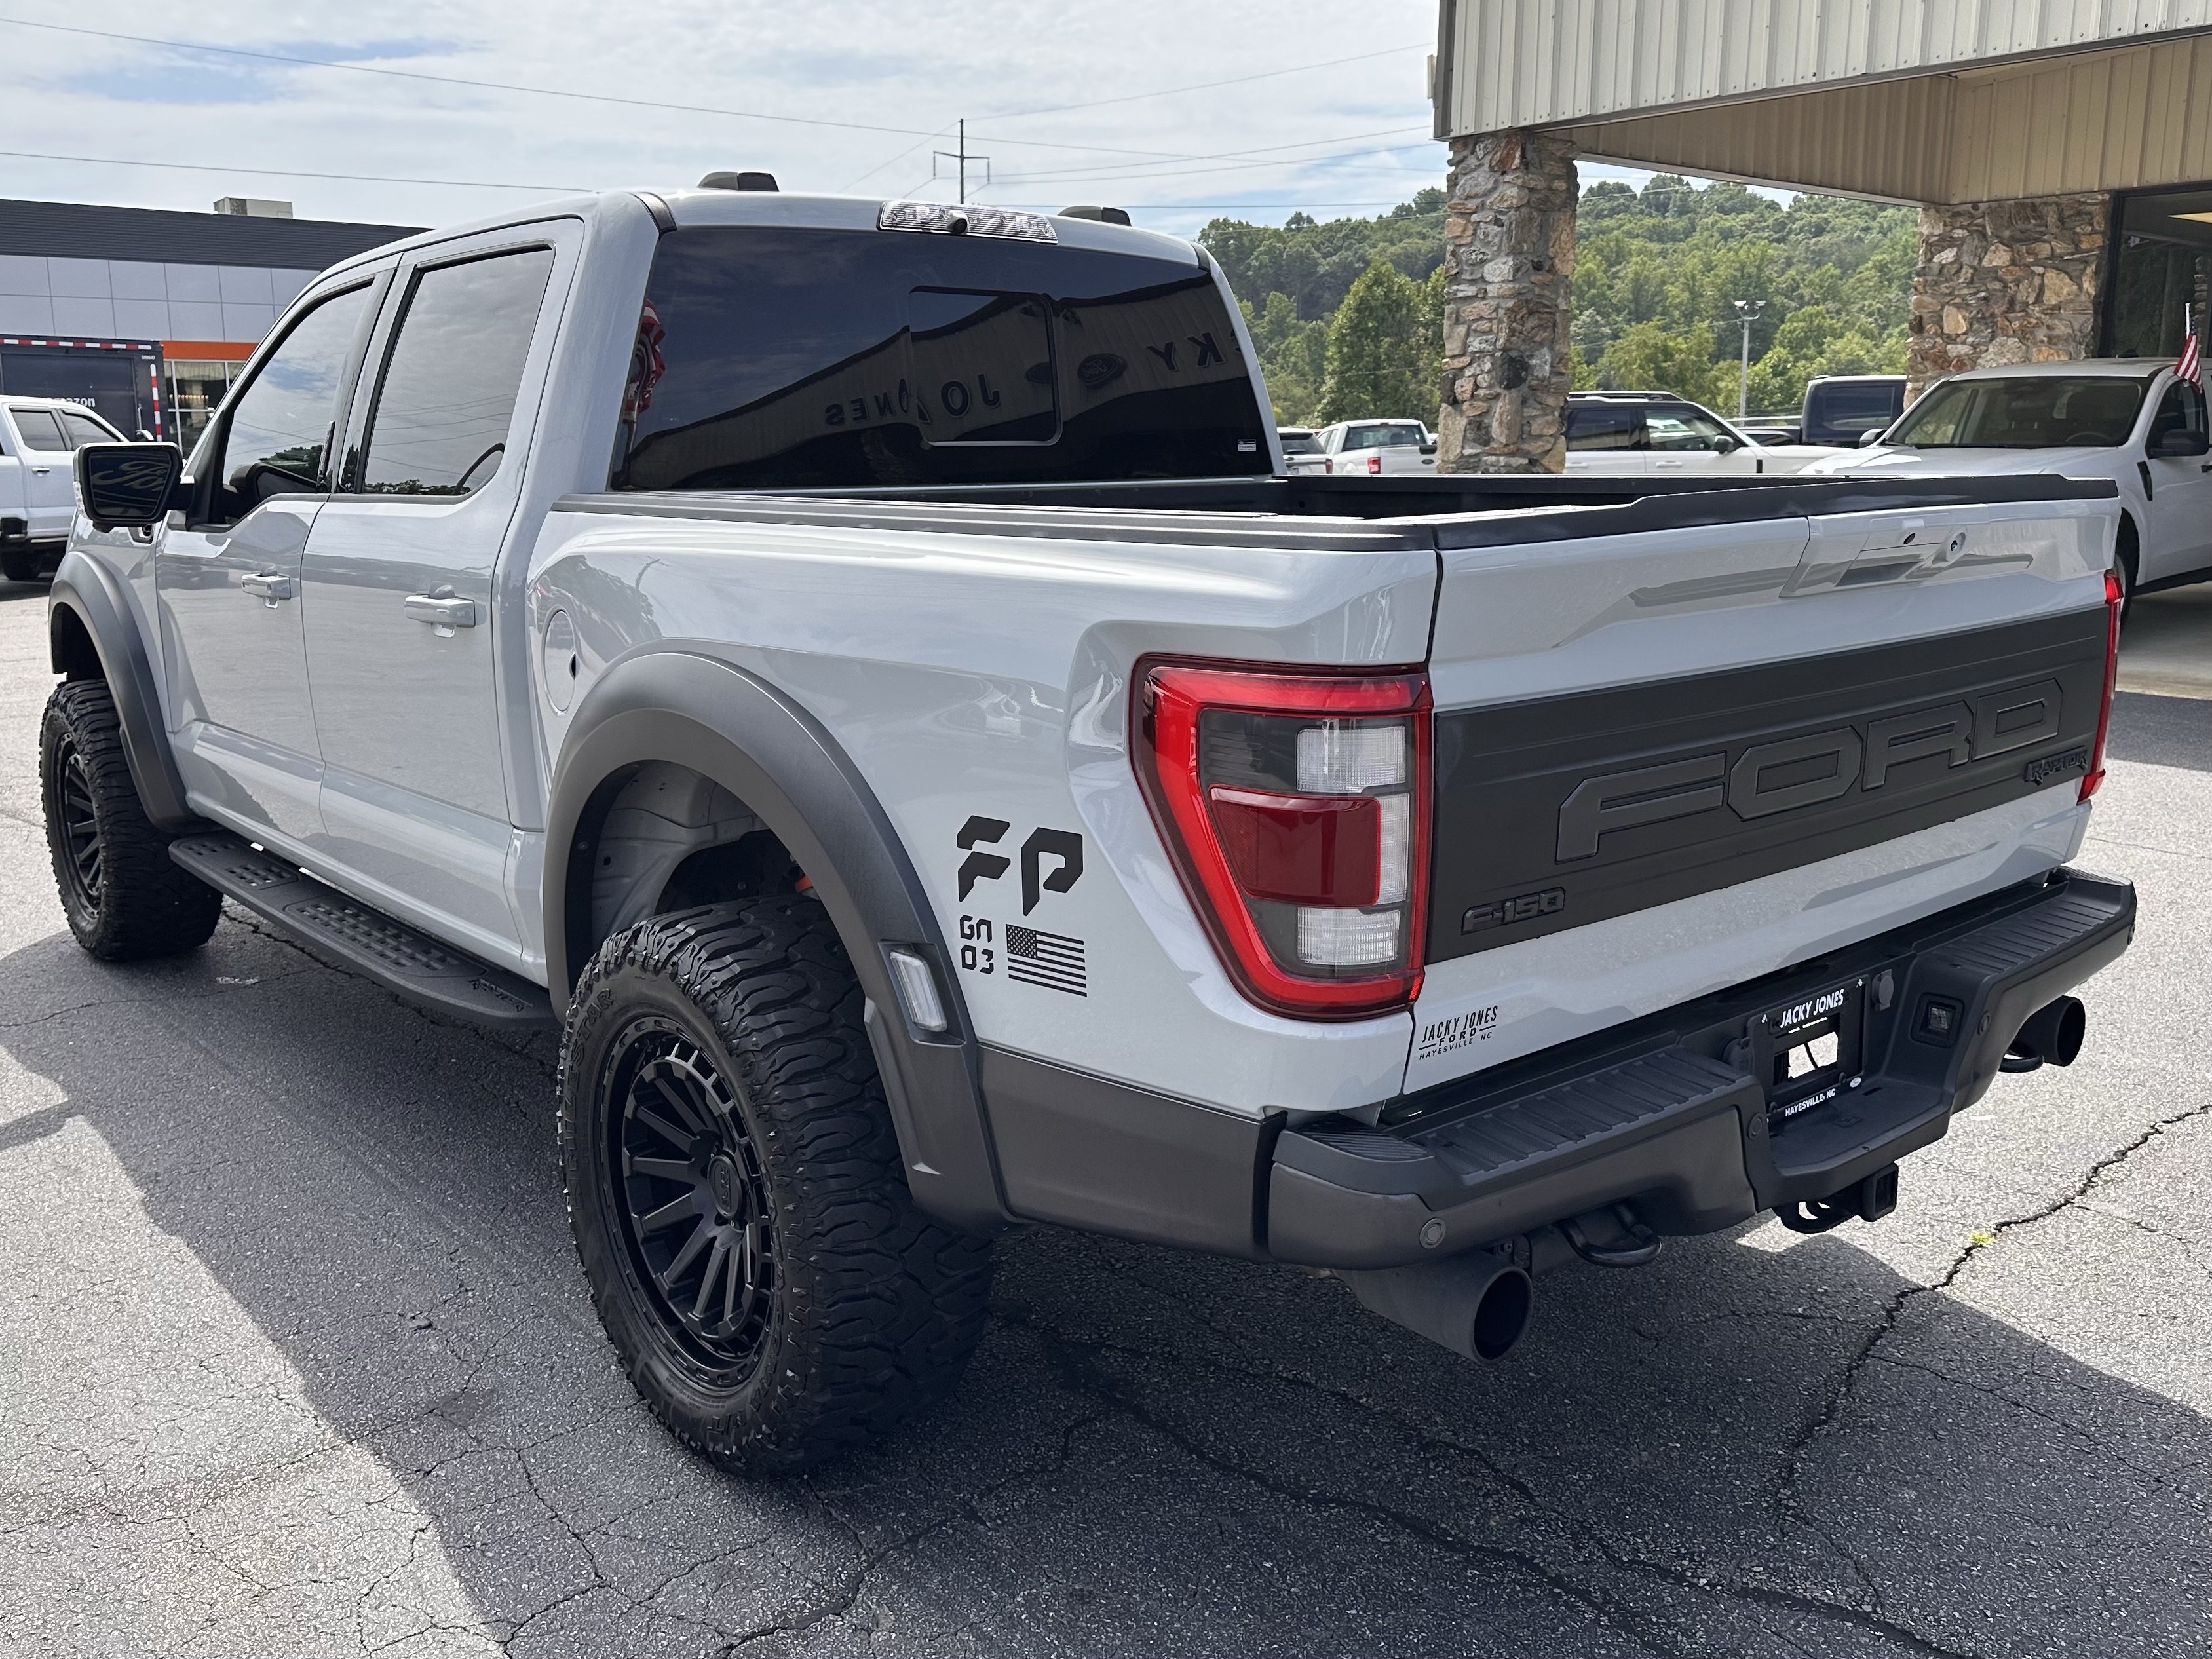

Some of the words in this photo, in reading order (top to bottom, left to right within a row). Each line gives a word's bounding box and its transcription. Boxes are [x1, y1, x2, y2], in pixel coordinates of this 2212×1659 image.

[1556, 678, 2063, 864] FORD
[2025, 748, 2088, 784] RAPTOR
[957, 815, 1083, 916] FP
[1461, 887, 1565, 935] F-150
[1422, 1016, 1460, 1043] JACKY
[1462, 1005, 1498, 1031] JONES
[1780, 1001, 1812, 1028] JACKY
[1813, 989, 1844, 1016] JONES
[1419, 1037, 1473, 1060] HAYESVILLE
[1480, 1031, 1492, 1041] NC
[1438, 1027, 1476, 1047] FORD
[1826, 1088, 1835, 1098] NC
